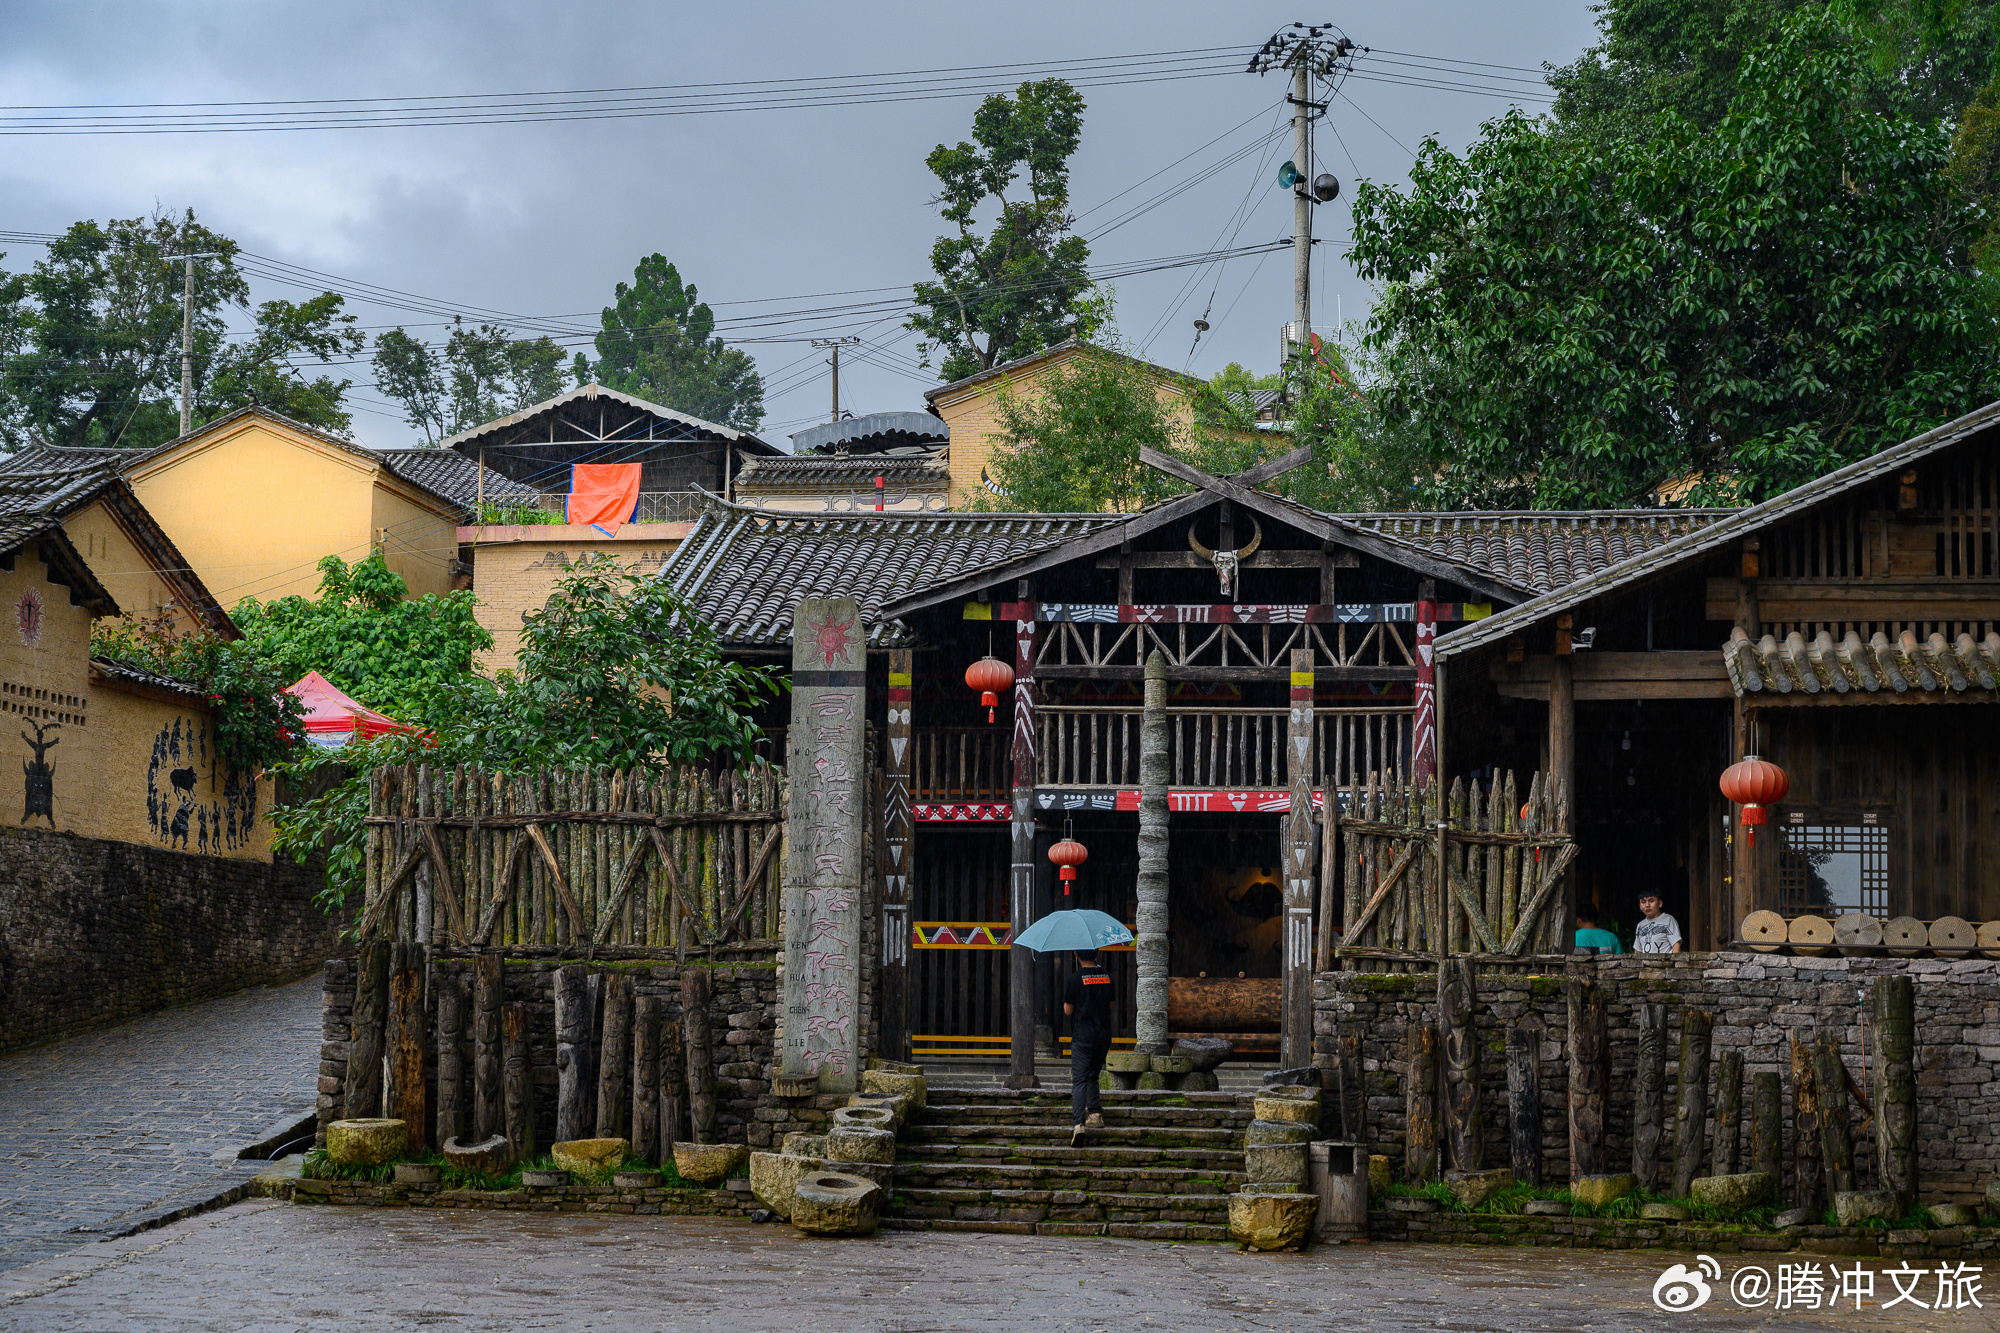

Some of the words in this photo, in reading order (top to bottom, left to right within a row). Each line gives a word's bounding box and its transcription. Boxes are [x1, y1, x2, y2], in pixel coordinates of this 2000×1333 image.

[794, 716, 811, 725] SI
[794, 748, 810, 756] MO
[793, 780, 809, 788] LA
[791, 876, 808, 884] MIN
[790, 908, 807, 917] SU
[789, 973, 806, 981] HUA
[788, 1006, 807, 1014] CHEN
[788, 1038, 805, 1047] LIE
